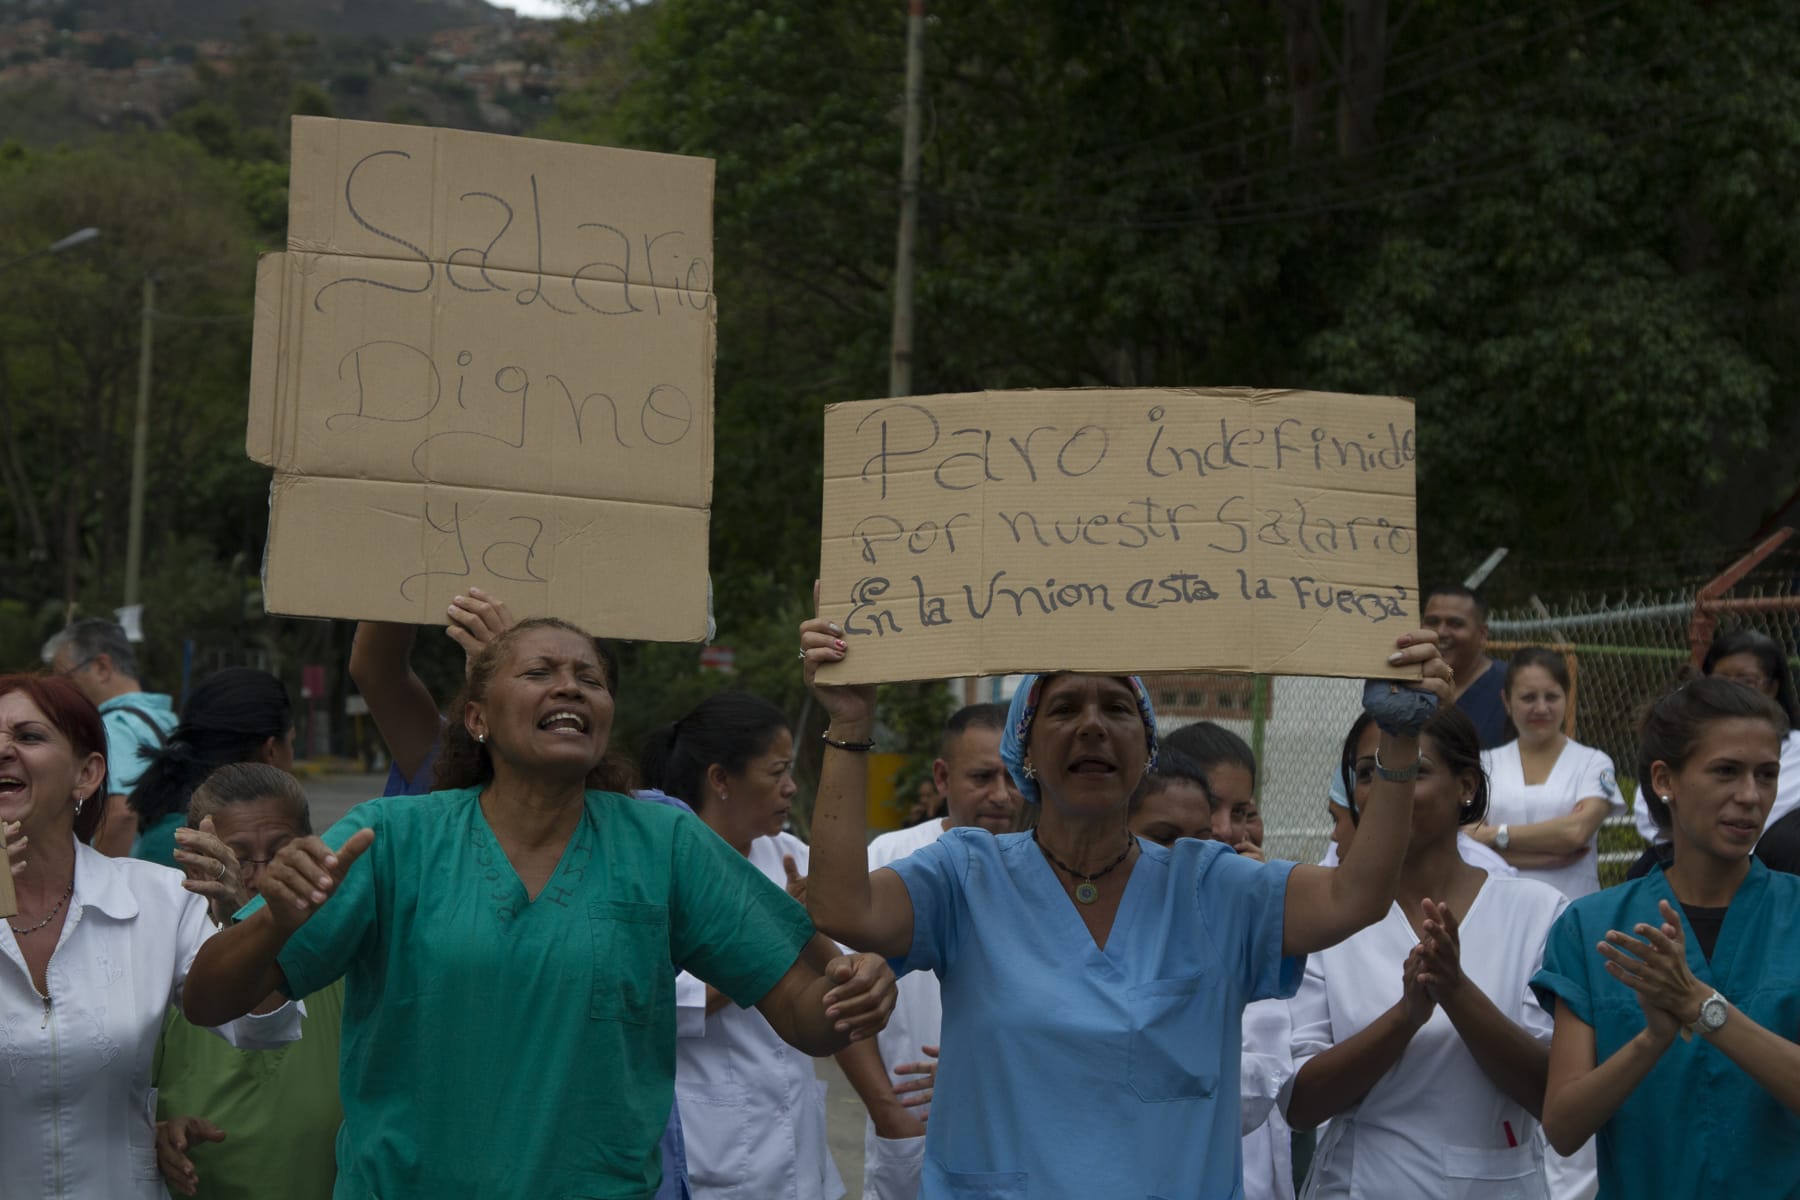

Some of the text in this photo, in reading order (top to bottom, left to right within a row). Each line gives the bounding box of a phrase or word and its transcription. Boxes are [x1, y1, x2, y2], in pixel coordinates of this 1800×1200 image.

[314, 149, 711, 316] Salario
[325, 340, 693, 484] Digno
[855, 403, 1109, 500] Paro
[911, 575, 953, 627] la
[963, 570, 1116, 619] Union
[1125, 570, 1220, 609] esta
[1236, 568, 1277, 600] la
